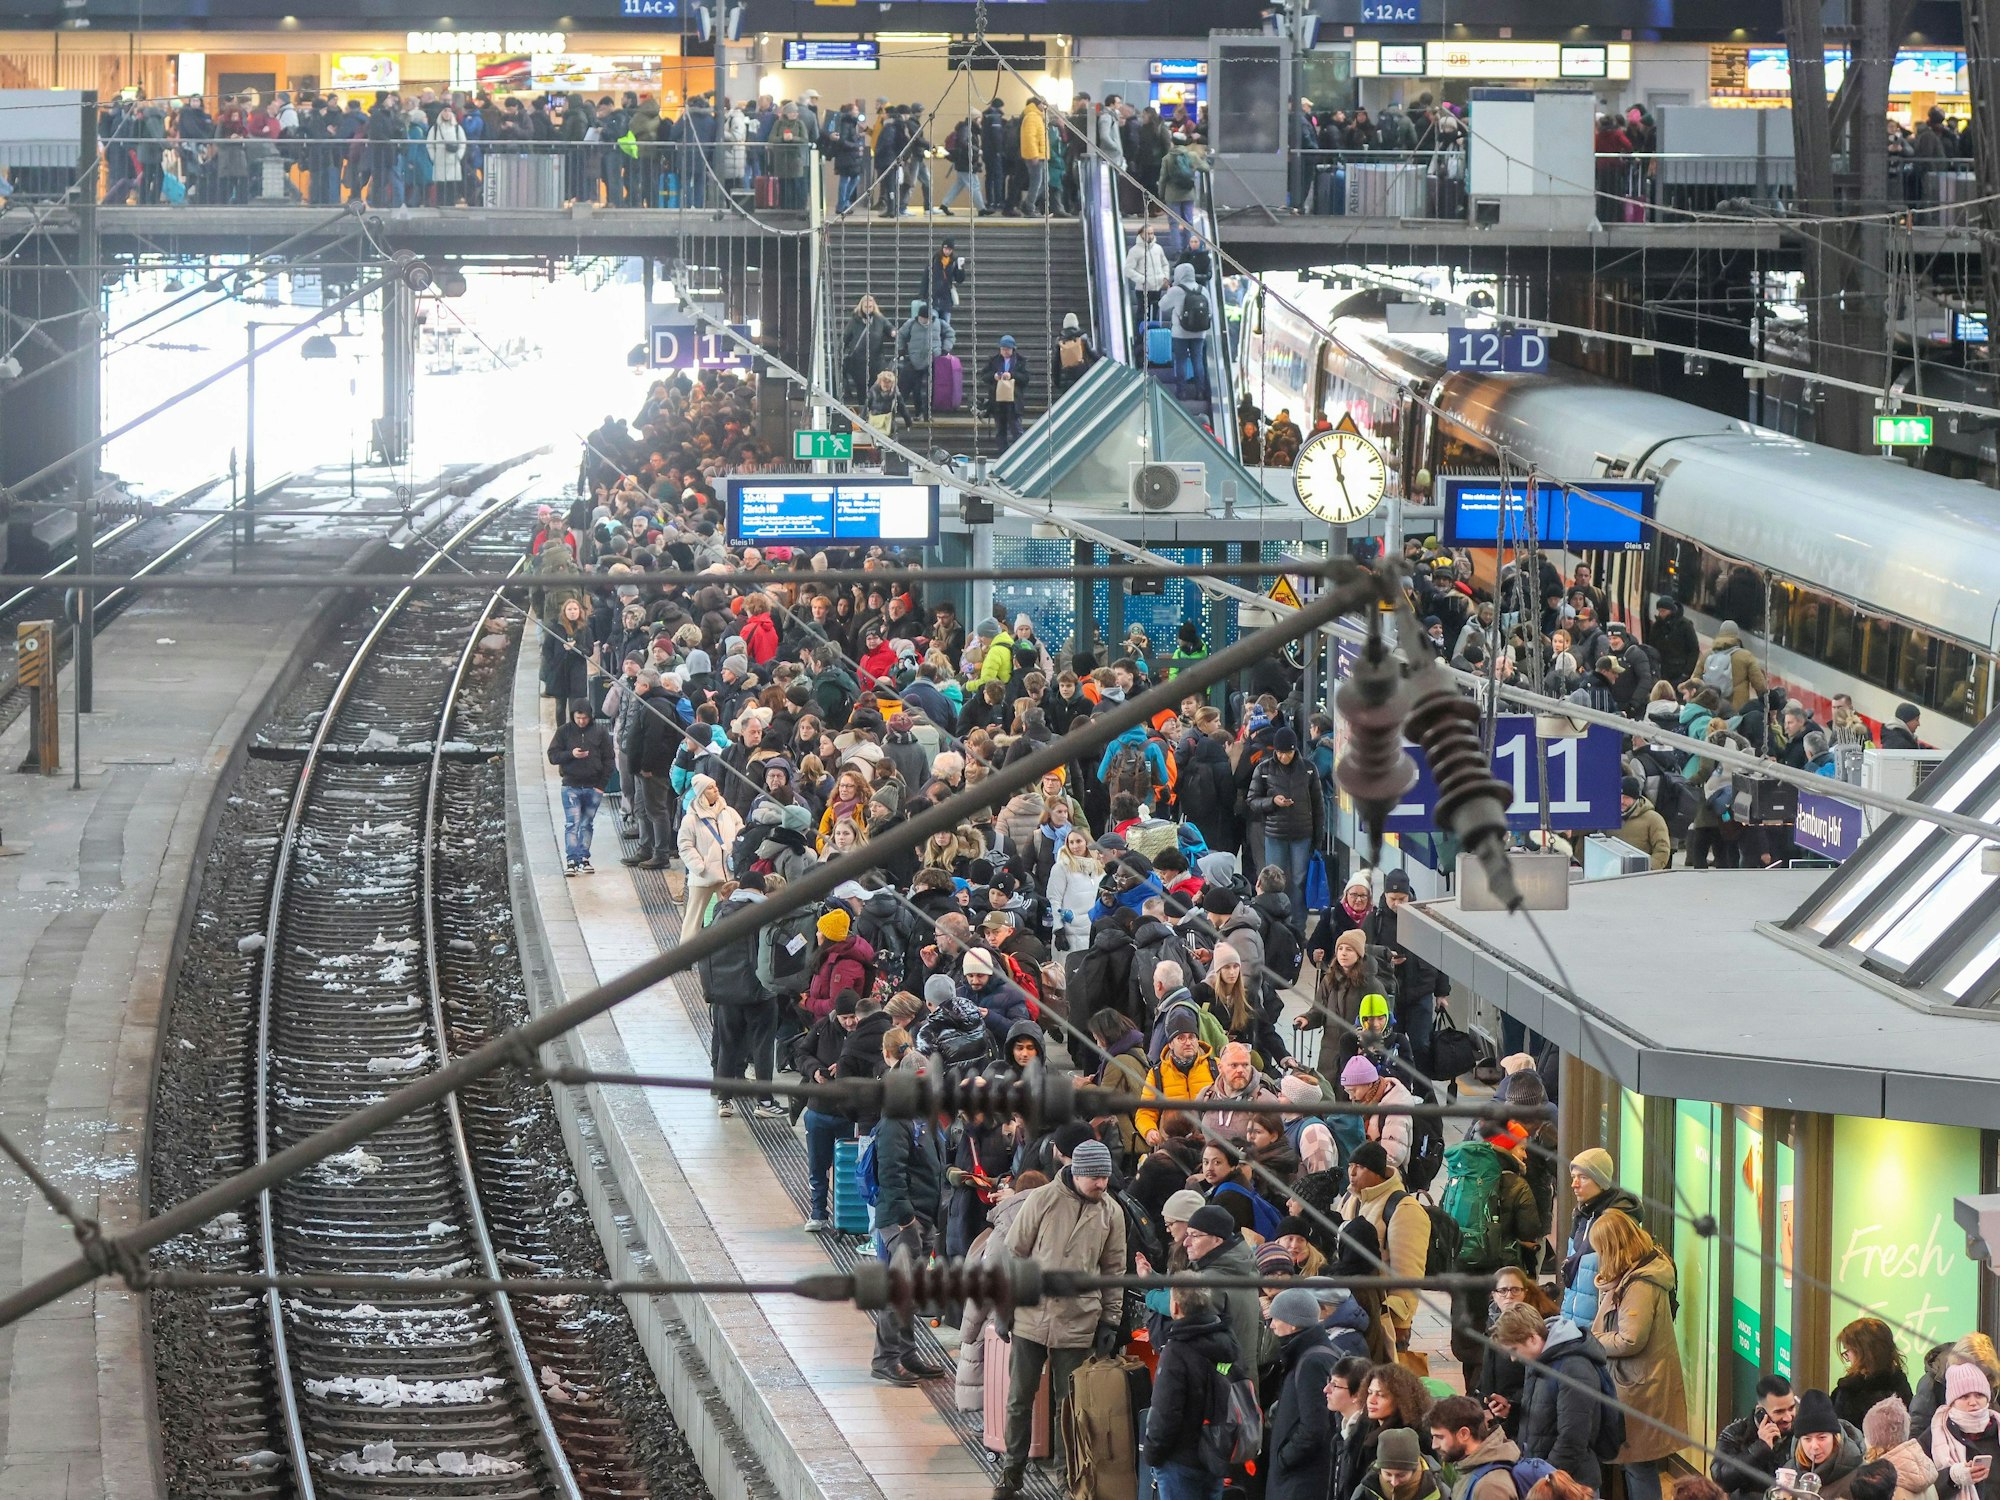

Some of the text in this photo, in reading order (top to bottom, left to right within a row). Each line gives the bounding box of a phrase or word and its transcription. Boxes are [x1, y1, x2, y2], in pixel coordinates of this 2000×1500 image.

[624, 0, 663, 14] 11 A-C
[1376, 4, 1416, 20] 12 A-C
[1451, 54, 1467, 64] DB
[655, 331, 678, 363] D
[1459, 333, 1545, 367] 12 D
[730, 538, 748, 546] Gleis
[1624, 542, 1651, 550] Gleis 12
[1969, 653, 1976, 684] 2
[1495, 734, 1591, 815] 11
[1796, 802, 1842, 848] Hamburg Hbf
[1839, 1213, 1955, 1283] Fresh
